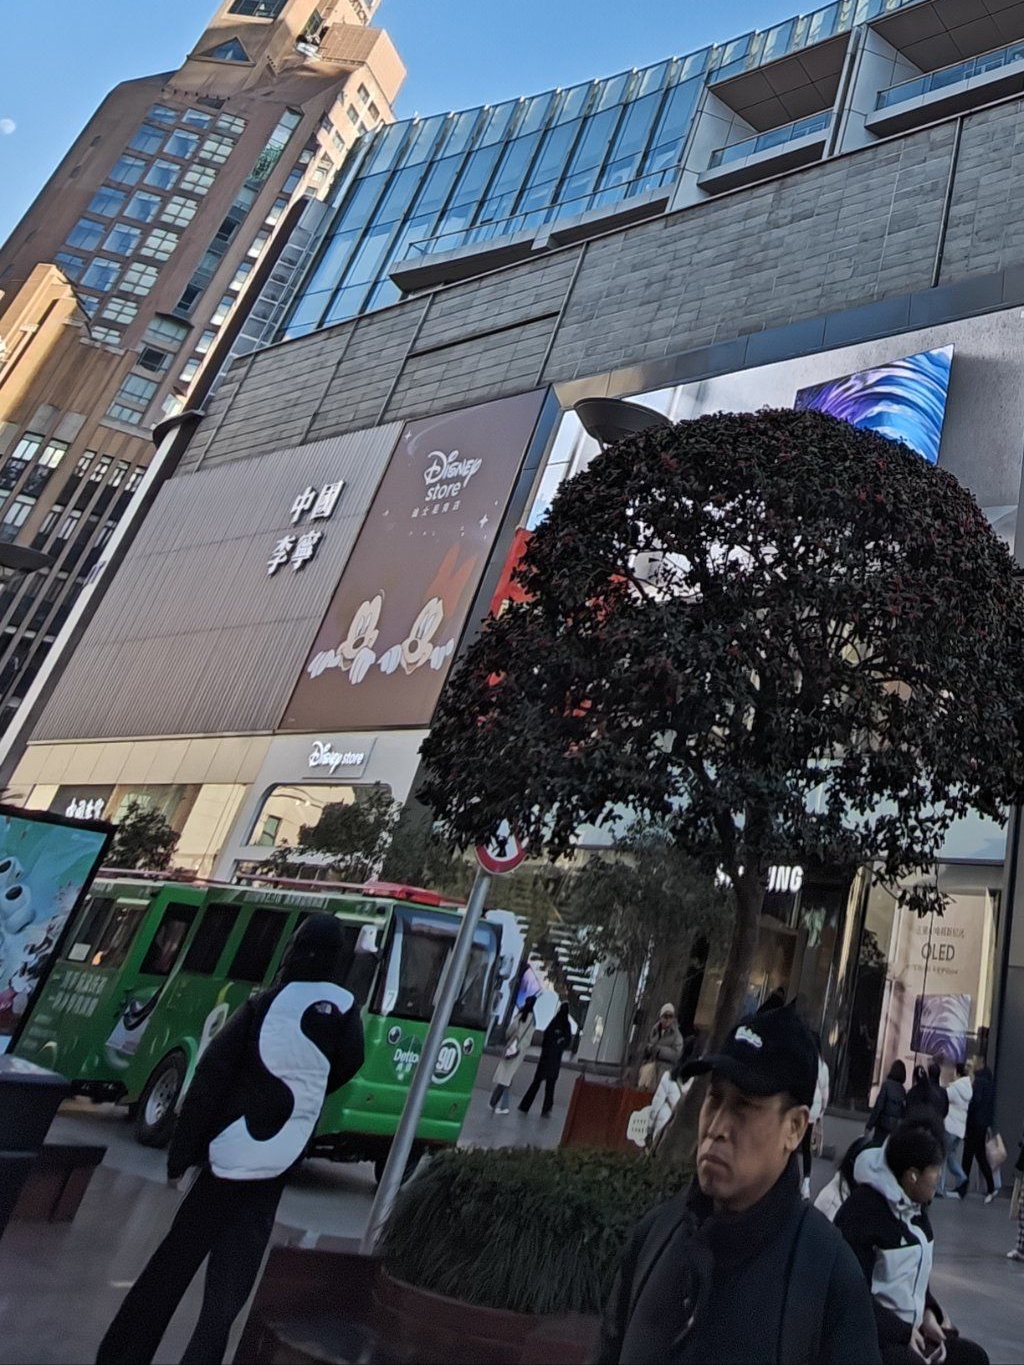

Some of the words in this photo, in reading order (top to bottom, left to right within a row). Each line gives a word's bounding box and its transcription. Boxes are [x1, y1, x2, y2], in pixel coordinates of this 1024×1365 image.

[424, 450, 482, 487] Disney
[425, 482, 461, 501] store
[921, 943, 955, 961] OLED
[436, 1046, 457, 1071] 90
